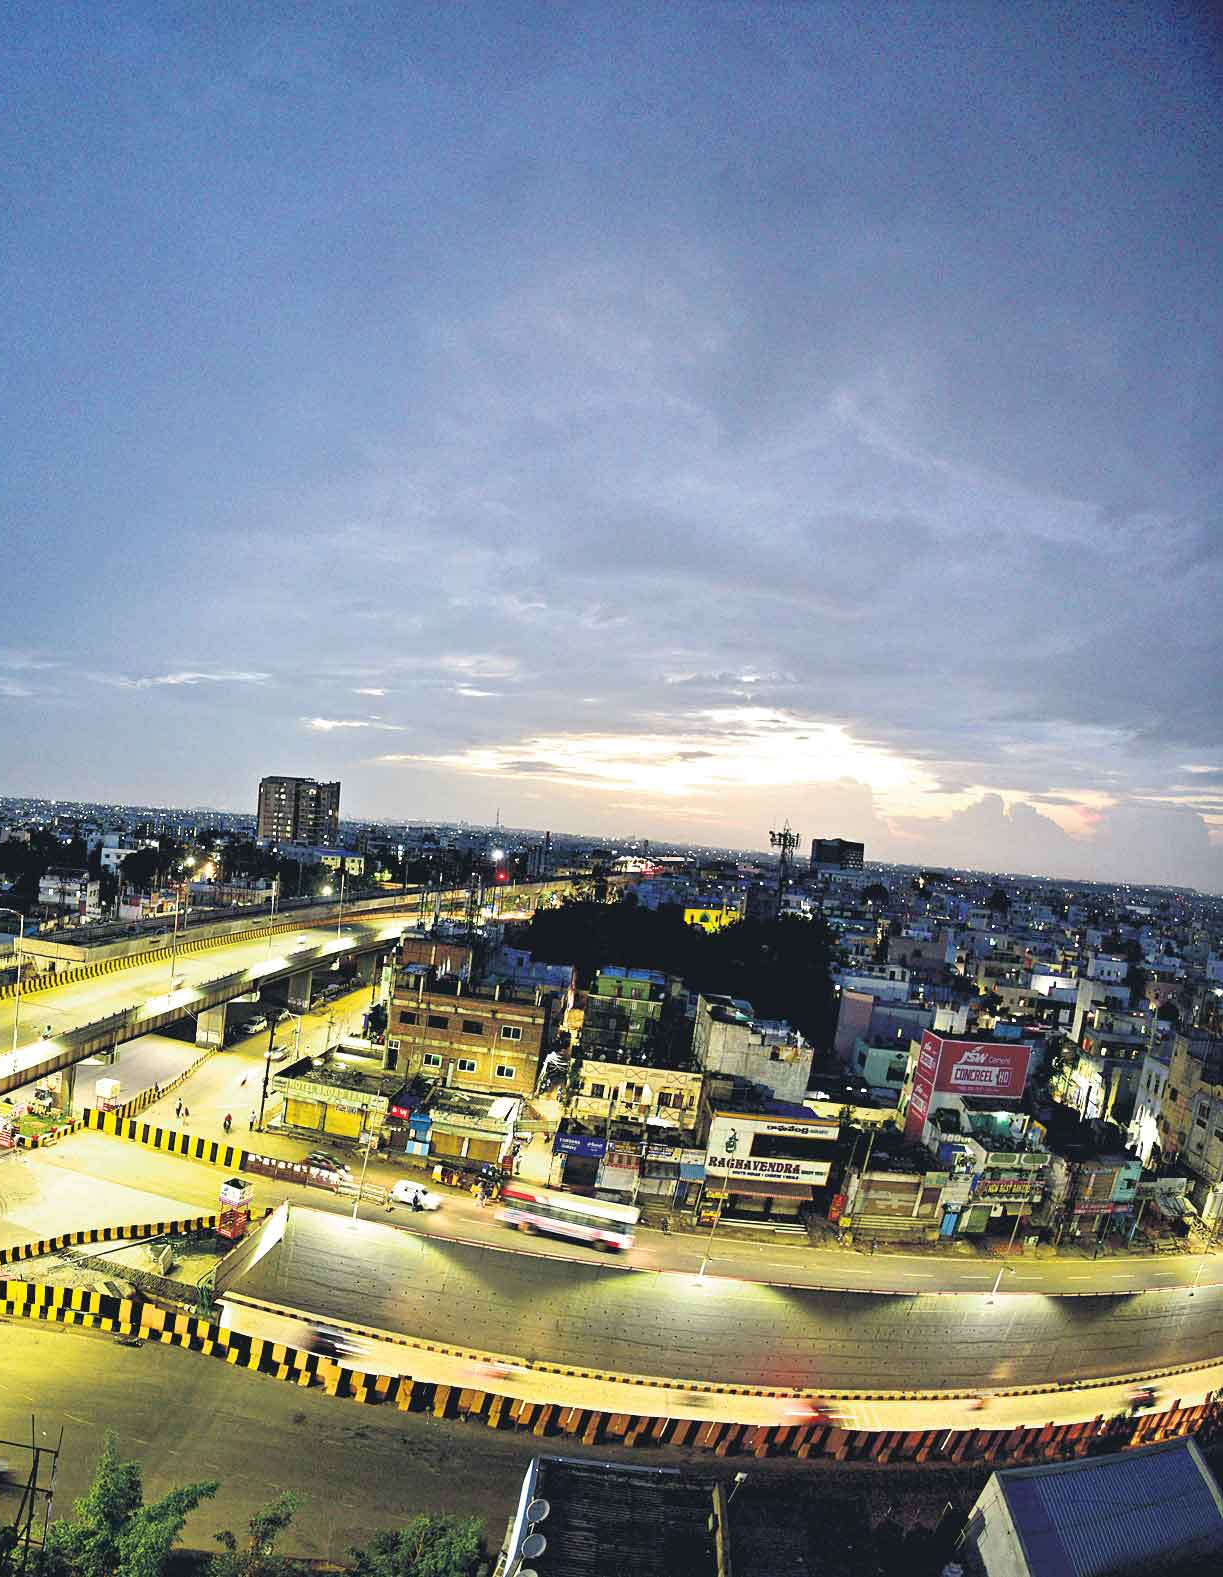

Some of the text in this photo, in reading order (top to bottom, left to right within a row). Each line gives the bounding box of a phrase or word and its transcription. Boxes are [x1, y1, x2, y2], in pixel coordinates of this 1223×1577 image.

[958, 1050, 989, 1064] JSW
[954, 1068, 993, 1082] CONCREEL
[708, 1157, 801, 1174] RAGHAVENDRA
